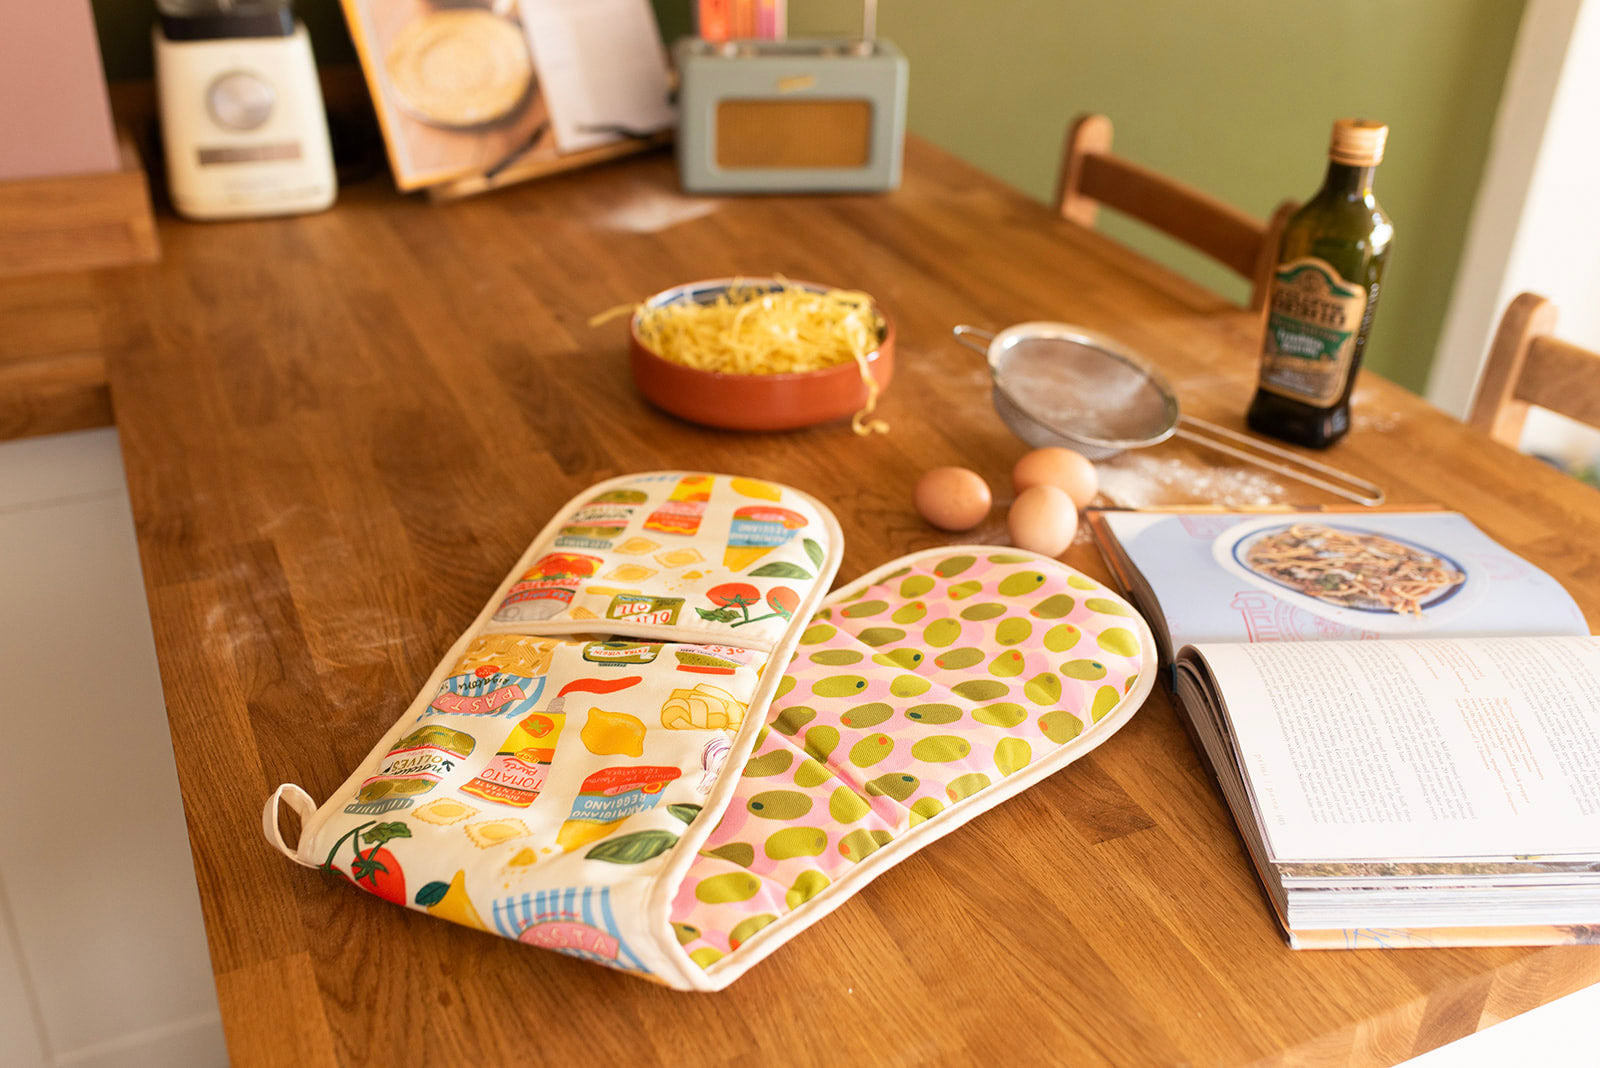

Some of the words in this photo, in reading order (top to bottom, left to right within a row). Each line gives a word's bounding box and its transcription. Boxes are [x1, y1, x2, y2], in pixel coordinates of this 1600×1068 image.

[620, 603, 650, 615] OIL
[593, 649, 621, 657] VIRGIN
[625, 648, 648, 656] EXTRA
[392, 754, 443, 772] OLIVES
[480, 768, 543, 790] TOMATO
[475, 780, 539, 798] CONCENTRATE
[584, 792, 647, 810] REGGIANO
